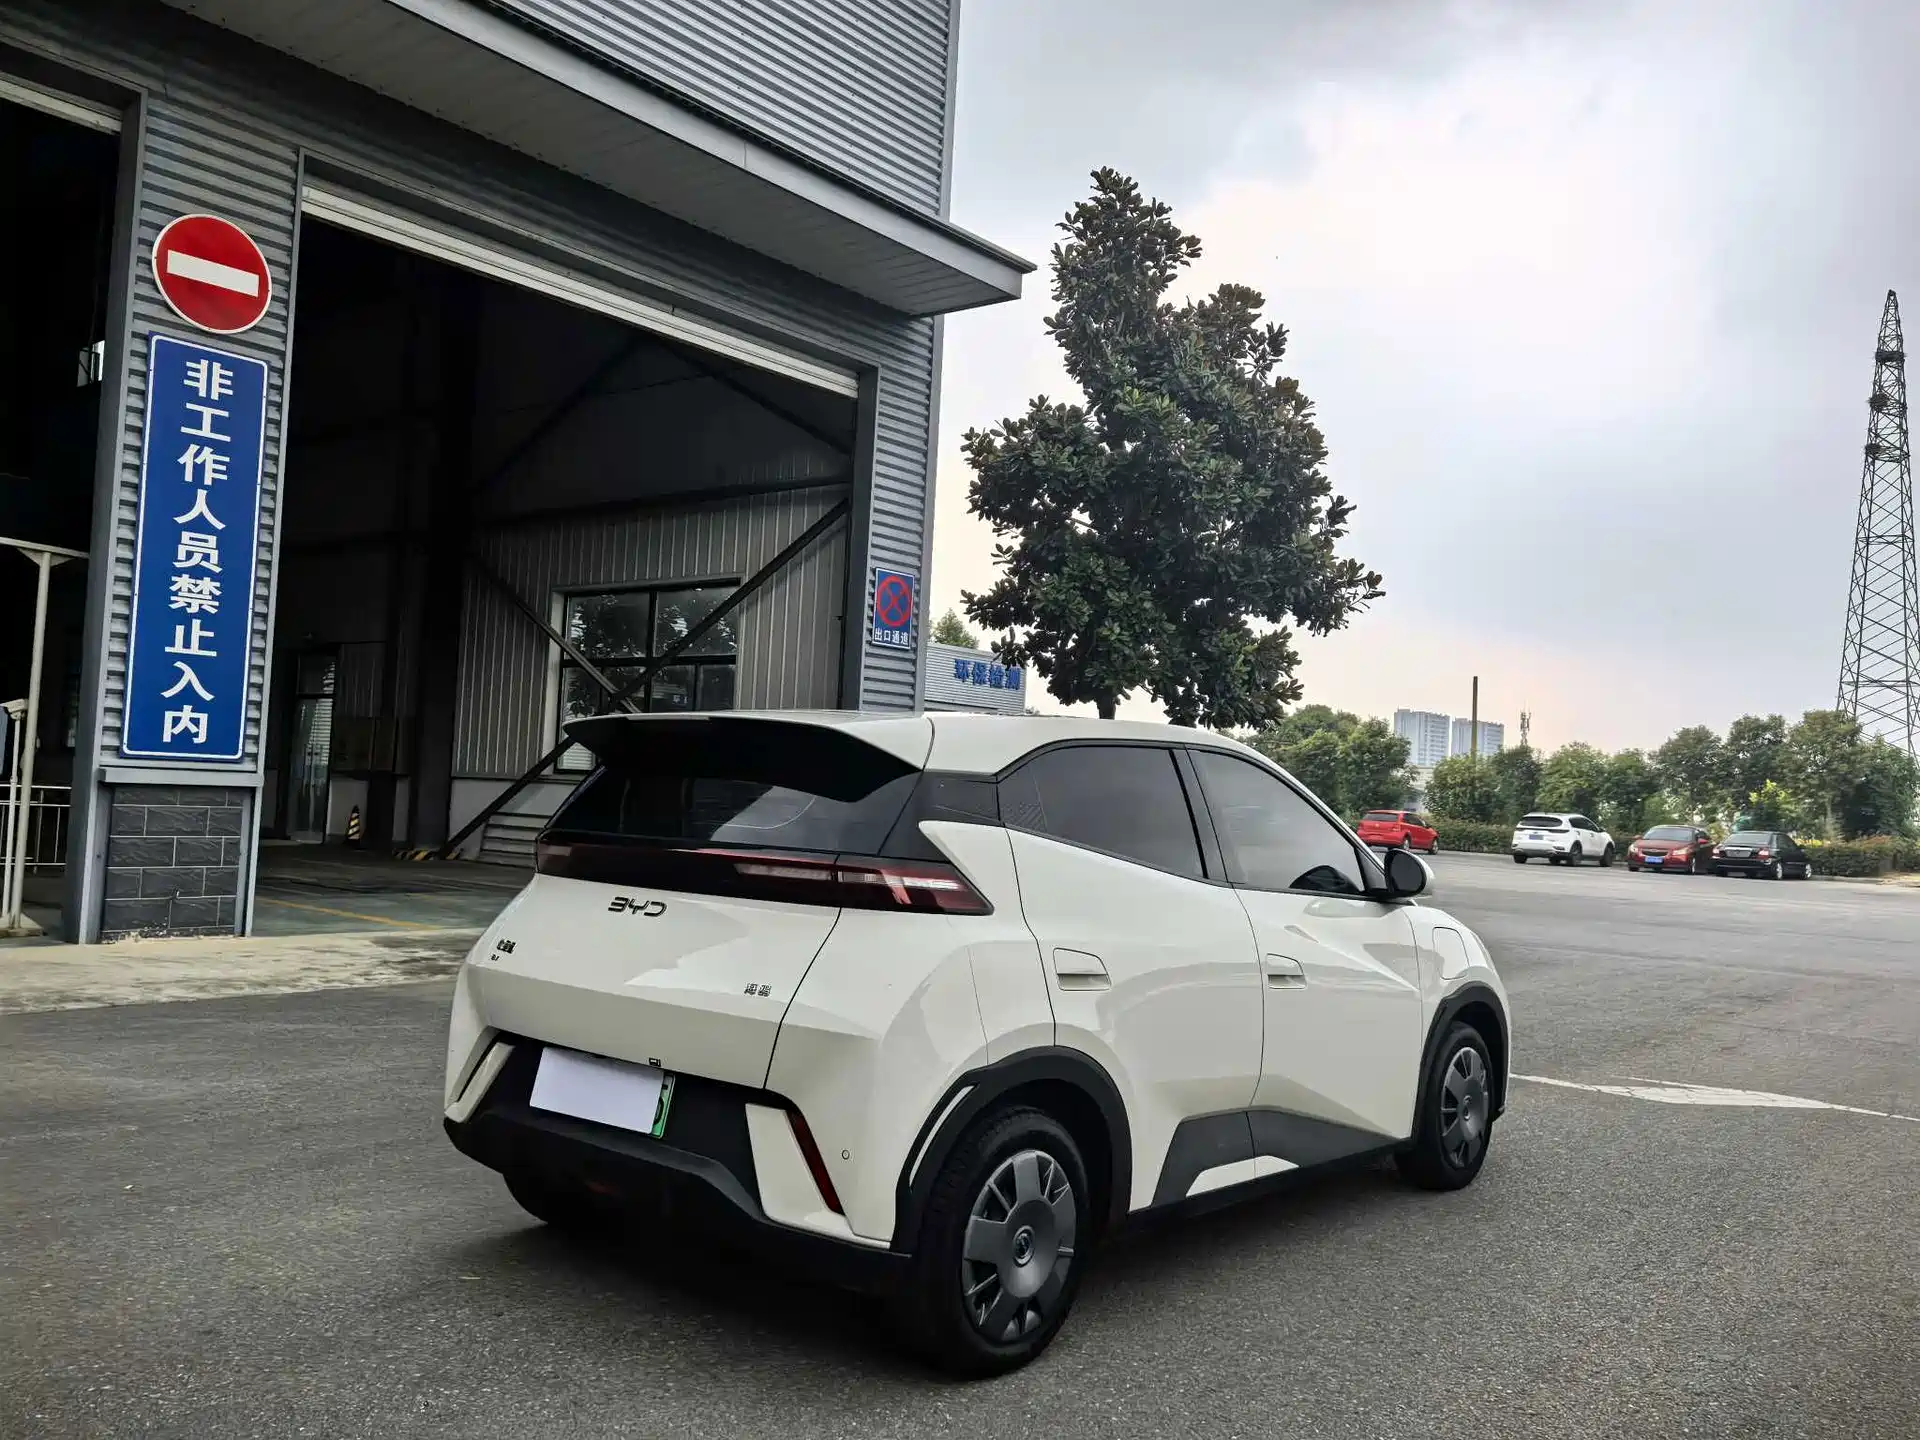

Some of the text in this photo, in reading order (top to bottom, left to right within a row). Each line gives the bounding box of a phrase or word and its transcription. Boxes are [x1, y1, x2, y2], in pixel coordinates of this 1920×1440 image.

[161, 358, 235, 745] 非工作人员禁止入内
[874, 627, 909, 645] 出口通道
[608, 896, 668, 917] BYD
